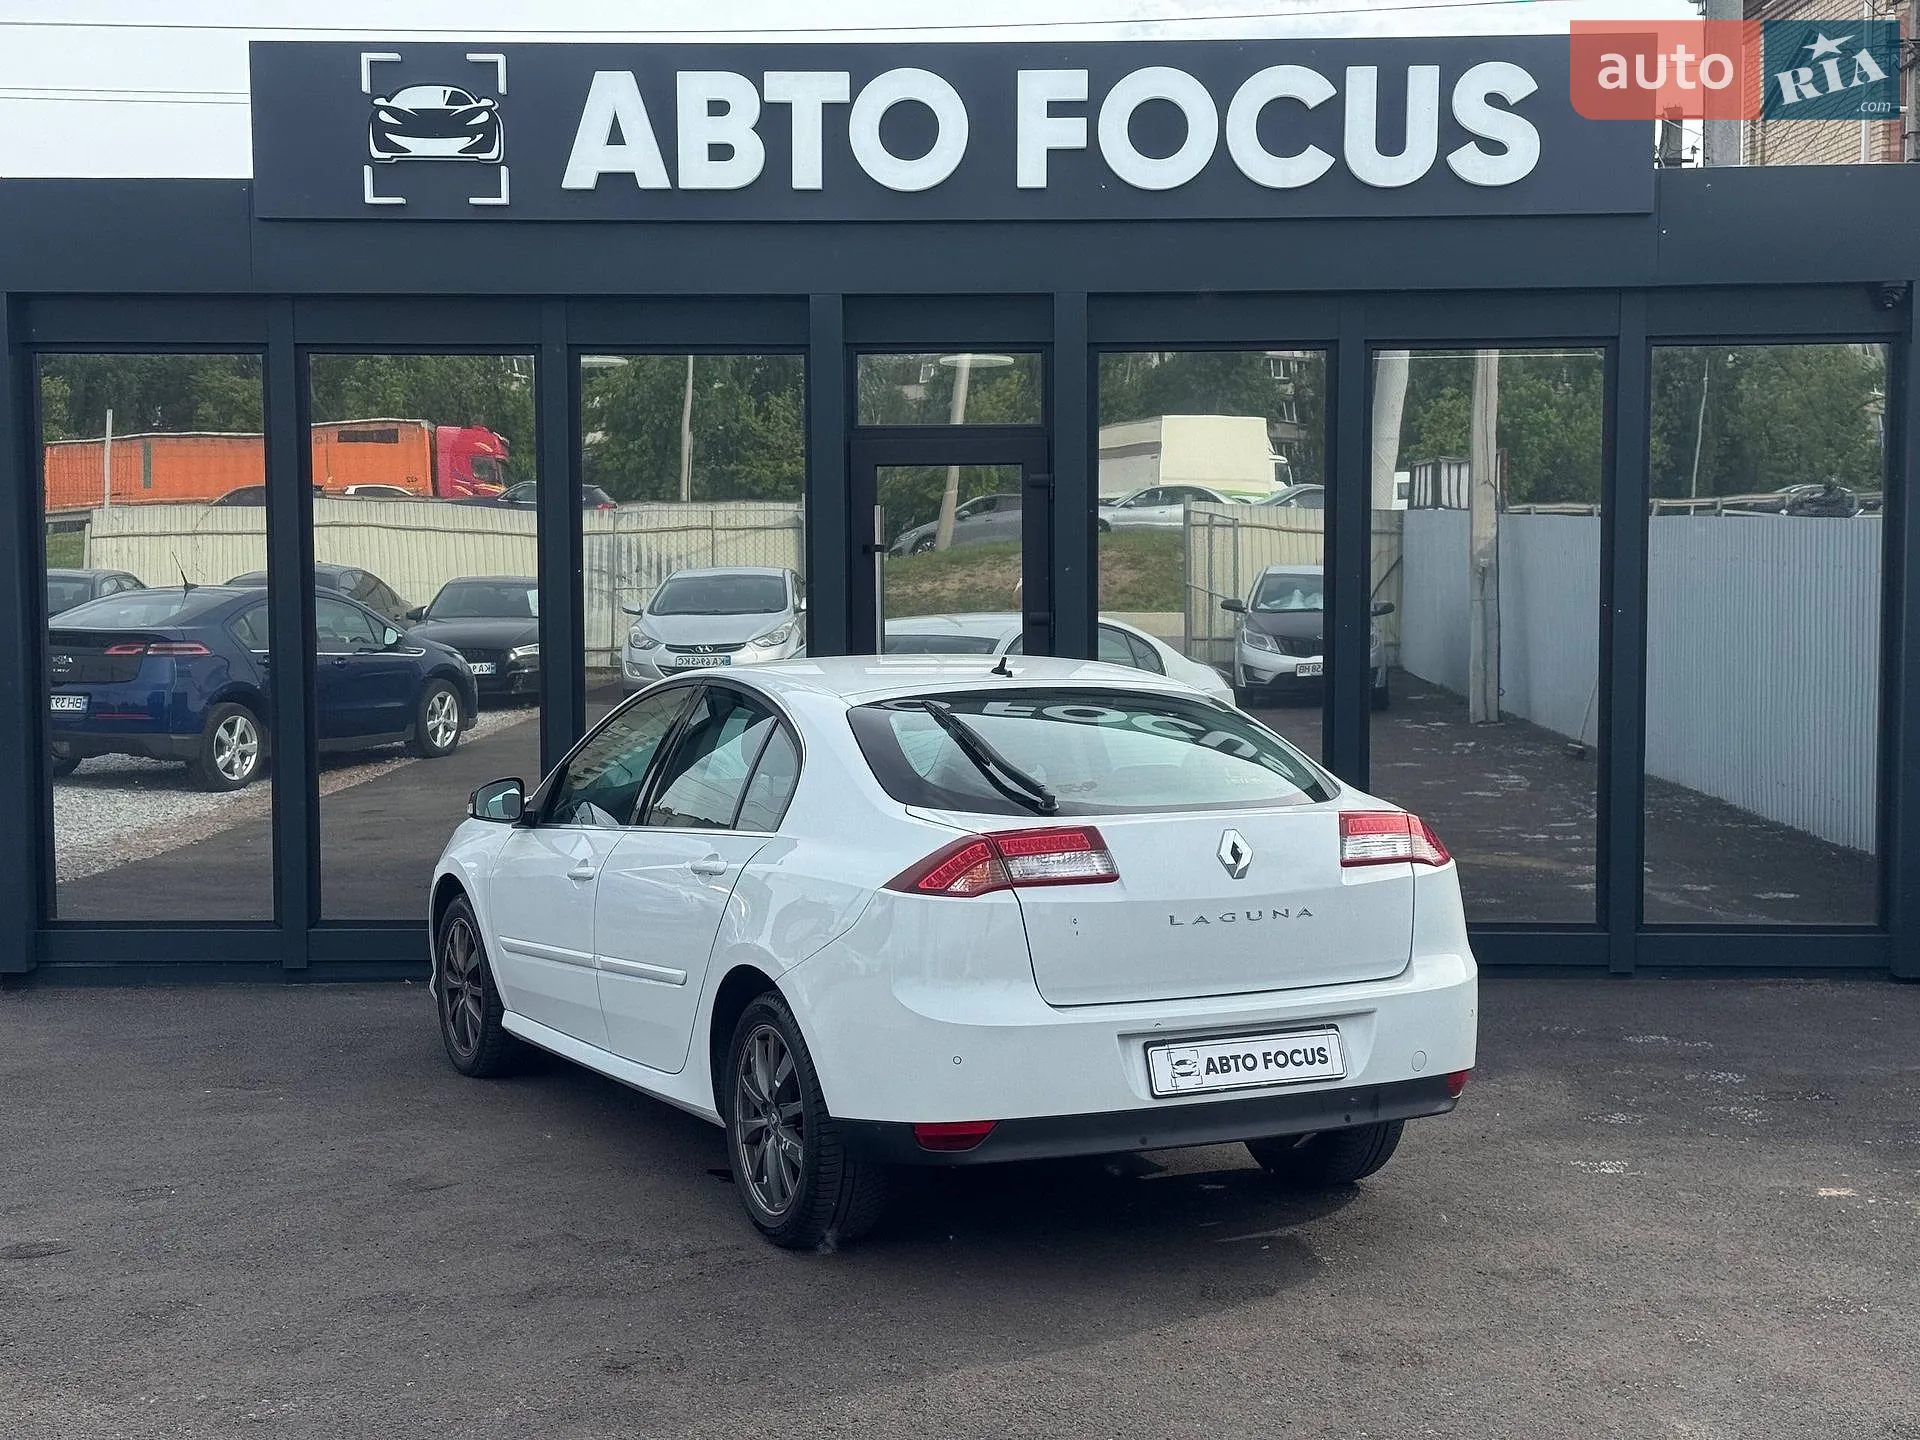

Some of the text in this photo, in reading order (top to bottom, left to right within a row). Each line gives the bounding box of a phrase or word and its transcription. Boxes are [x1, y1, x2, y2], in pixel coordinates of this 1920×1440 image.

[562, 62, 1541, 192] АВТО FOCUS
[1168, 905, 1313, 926] LAGUNA
[1205, 1046, 1329, 1076] АВТО FOCUS
